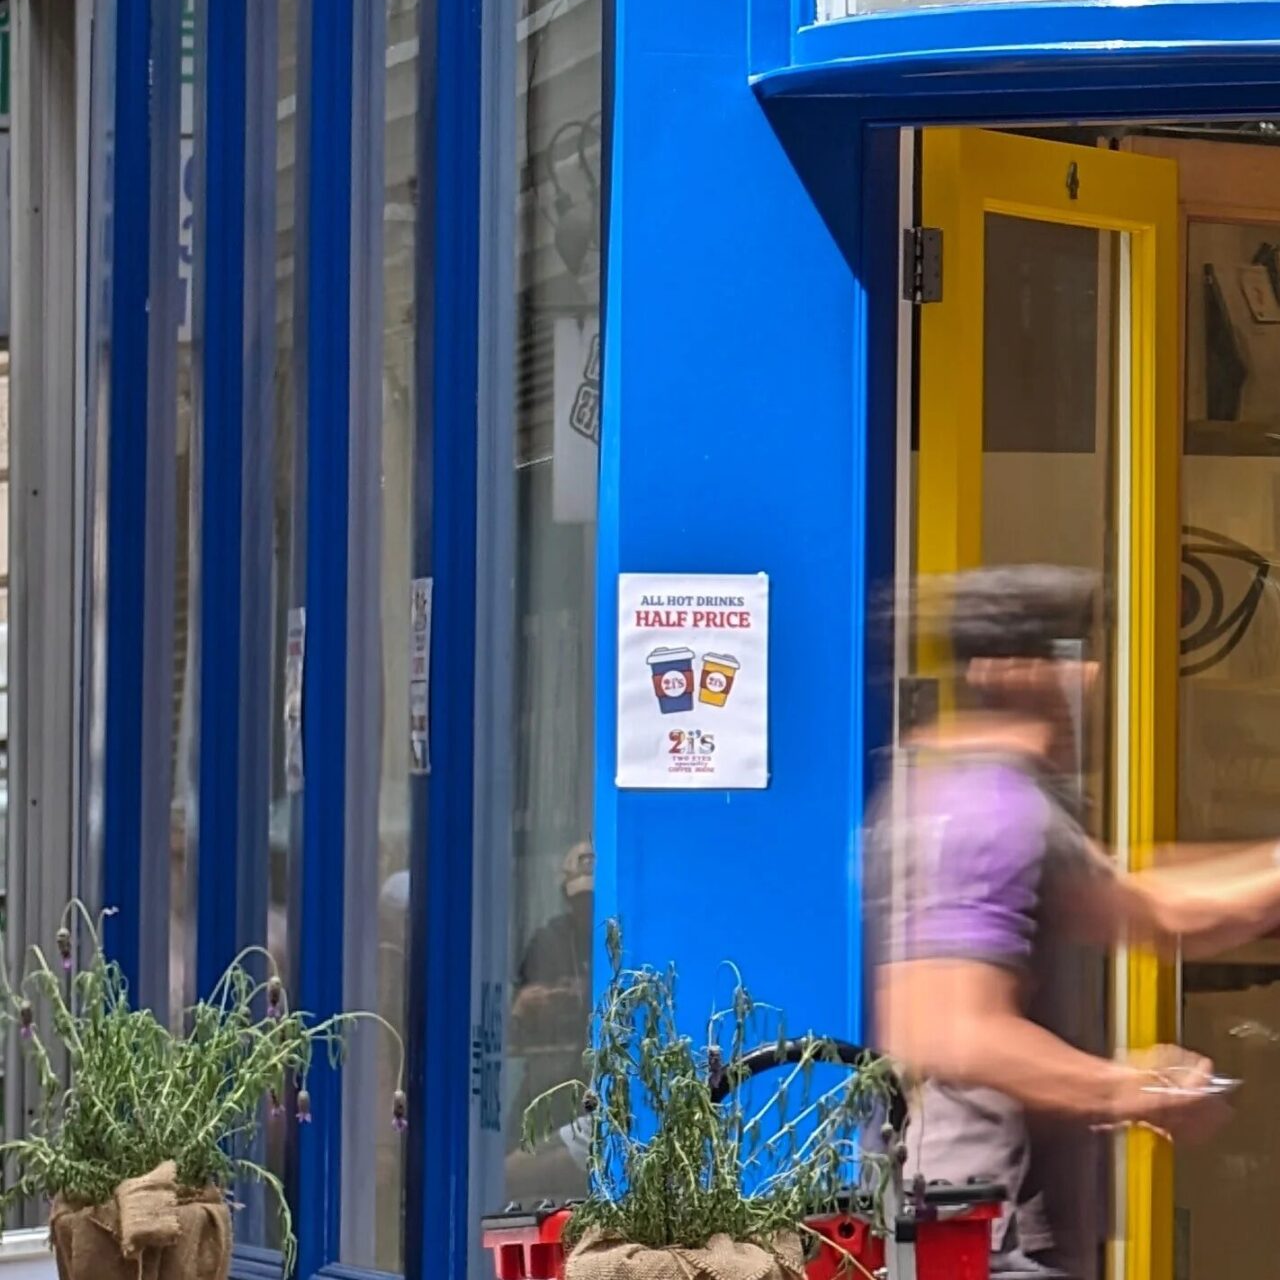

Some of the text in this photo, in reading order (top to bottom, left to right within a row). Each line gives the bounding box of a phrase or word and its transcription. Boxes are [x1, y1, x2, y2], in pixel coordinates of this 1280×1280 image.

[641, 595, 745, 607] ALL HOT DRINKS
[635, 610, 751, 628] HALF PRICE
[668, 729, 715, 755] 2i's
